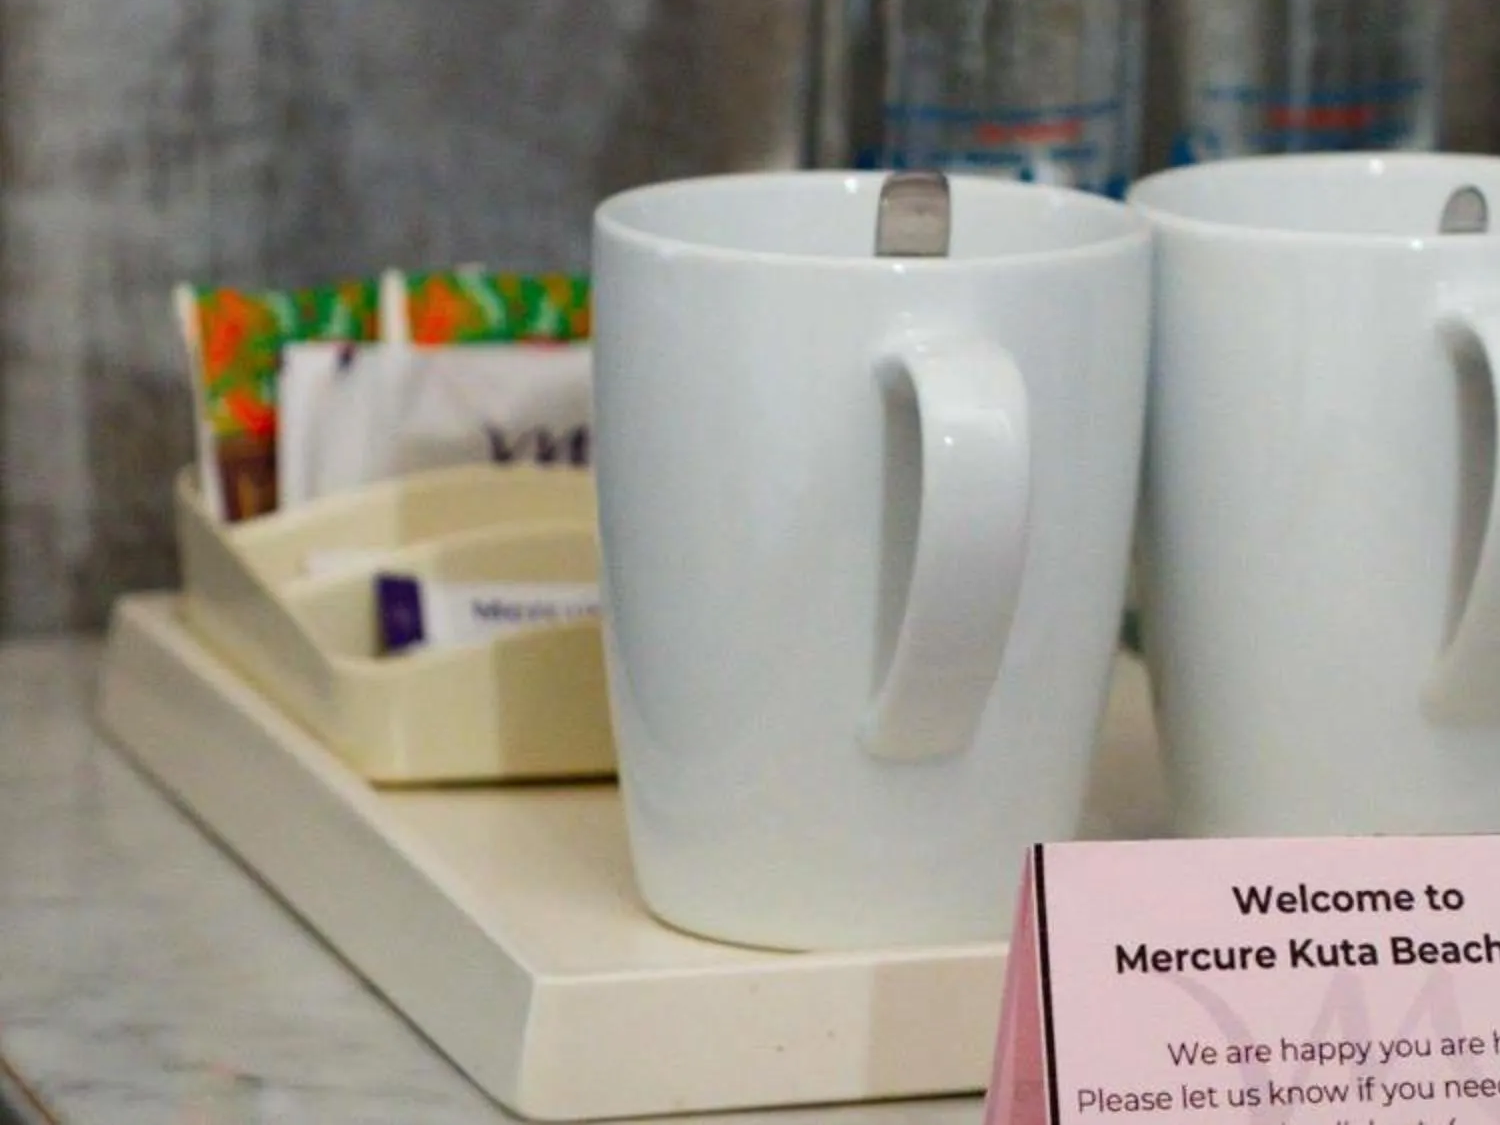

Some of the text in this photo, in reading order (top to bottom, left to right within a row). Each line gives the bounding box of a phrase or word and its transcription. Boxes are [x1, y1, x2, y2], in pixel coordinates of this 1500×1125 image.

[1231, 882, 1466, 916] Welcome to
[1115, 943, 1277, 975] Mercure
[1288, 938, 1379, 969] Kuta
[1167, 1042, 1218, 1067] We
[1226, 1044, 1272, 1065] are
[1280, 1038, 1372, 1066] happy
[1378, 1039, 1431, 1065] you
[1440, 1037, 1486, 1057] are
[1077, 1087, 1174, 1114] Please
[1181, 1084, 1219, 1110] let
[1227, 1087, 1262, 1108] us
[1267, 1079, 1350, 1106] know
[1357, 1075, 1376, 1103] if
[1380, 1081, 1436, 1107] you
